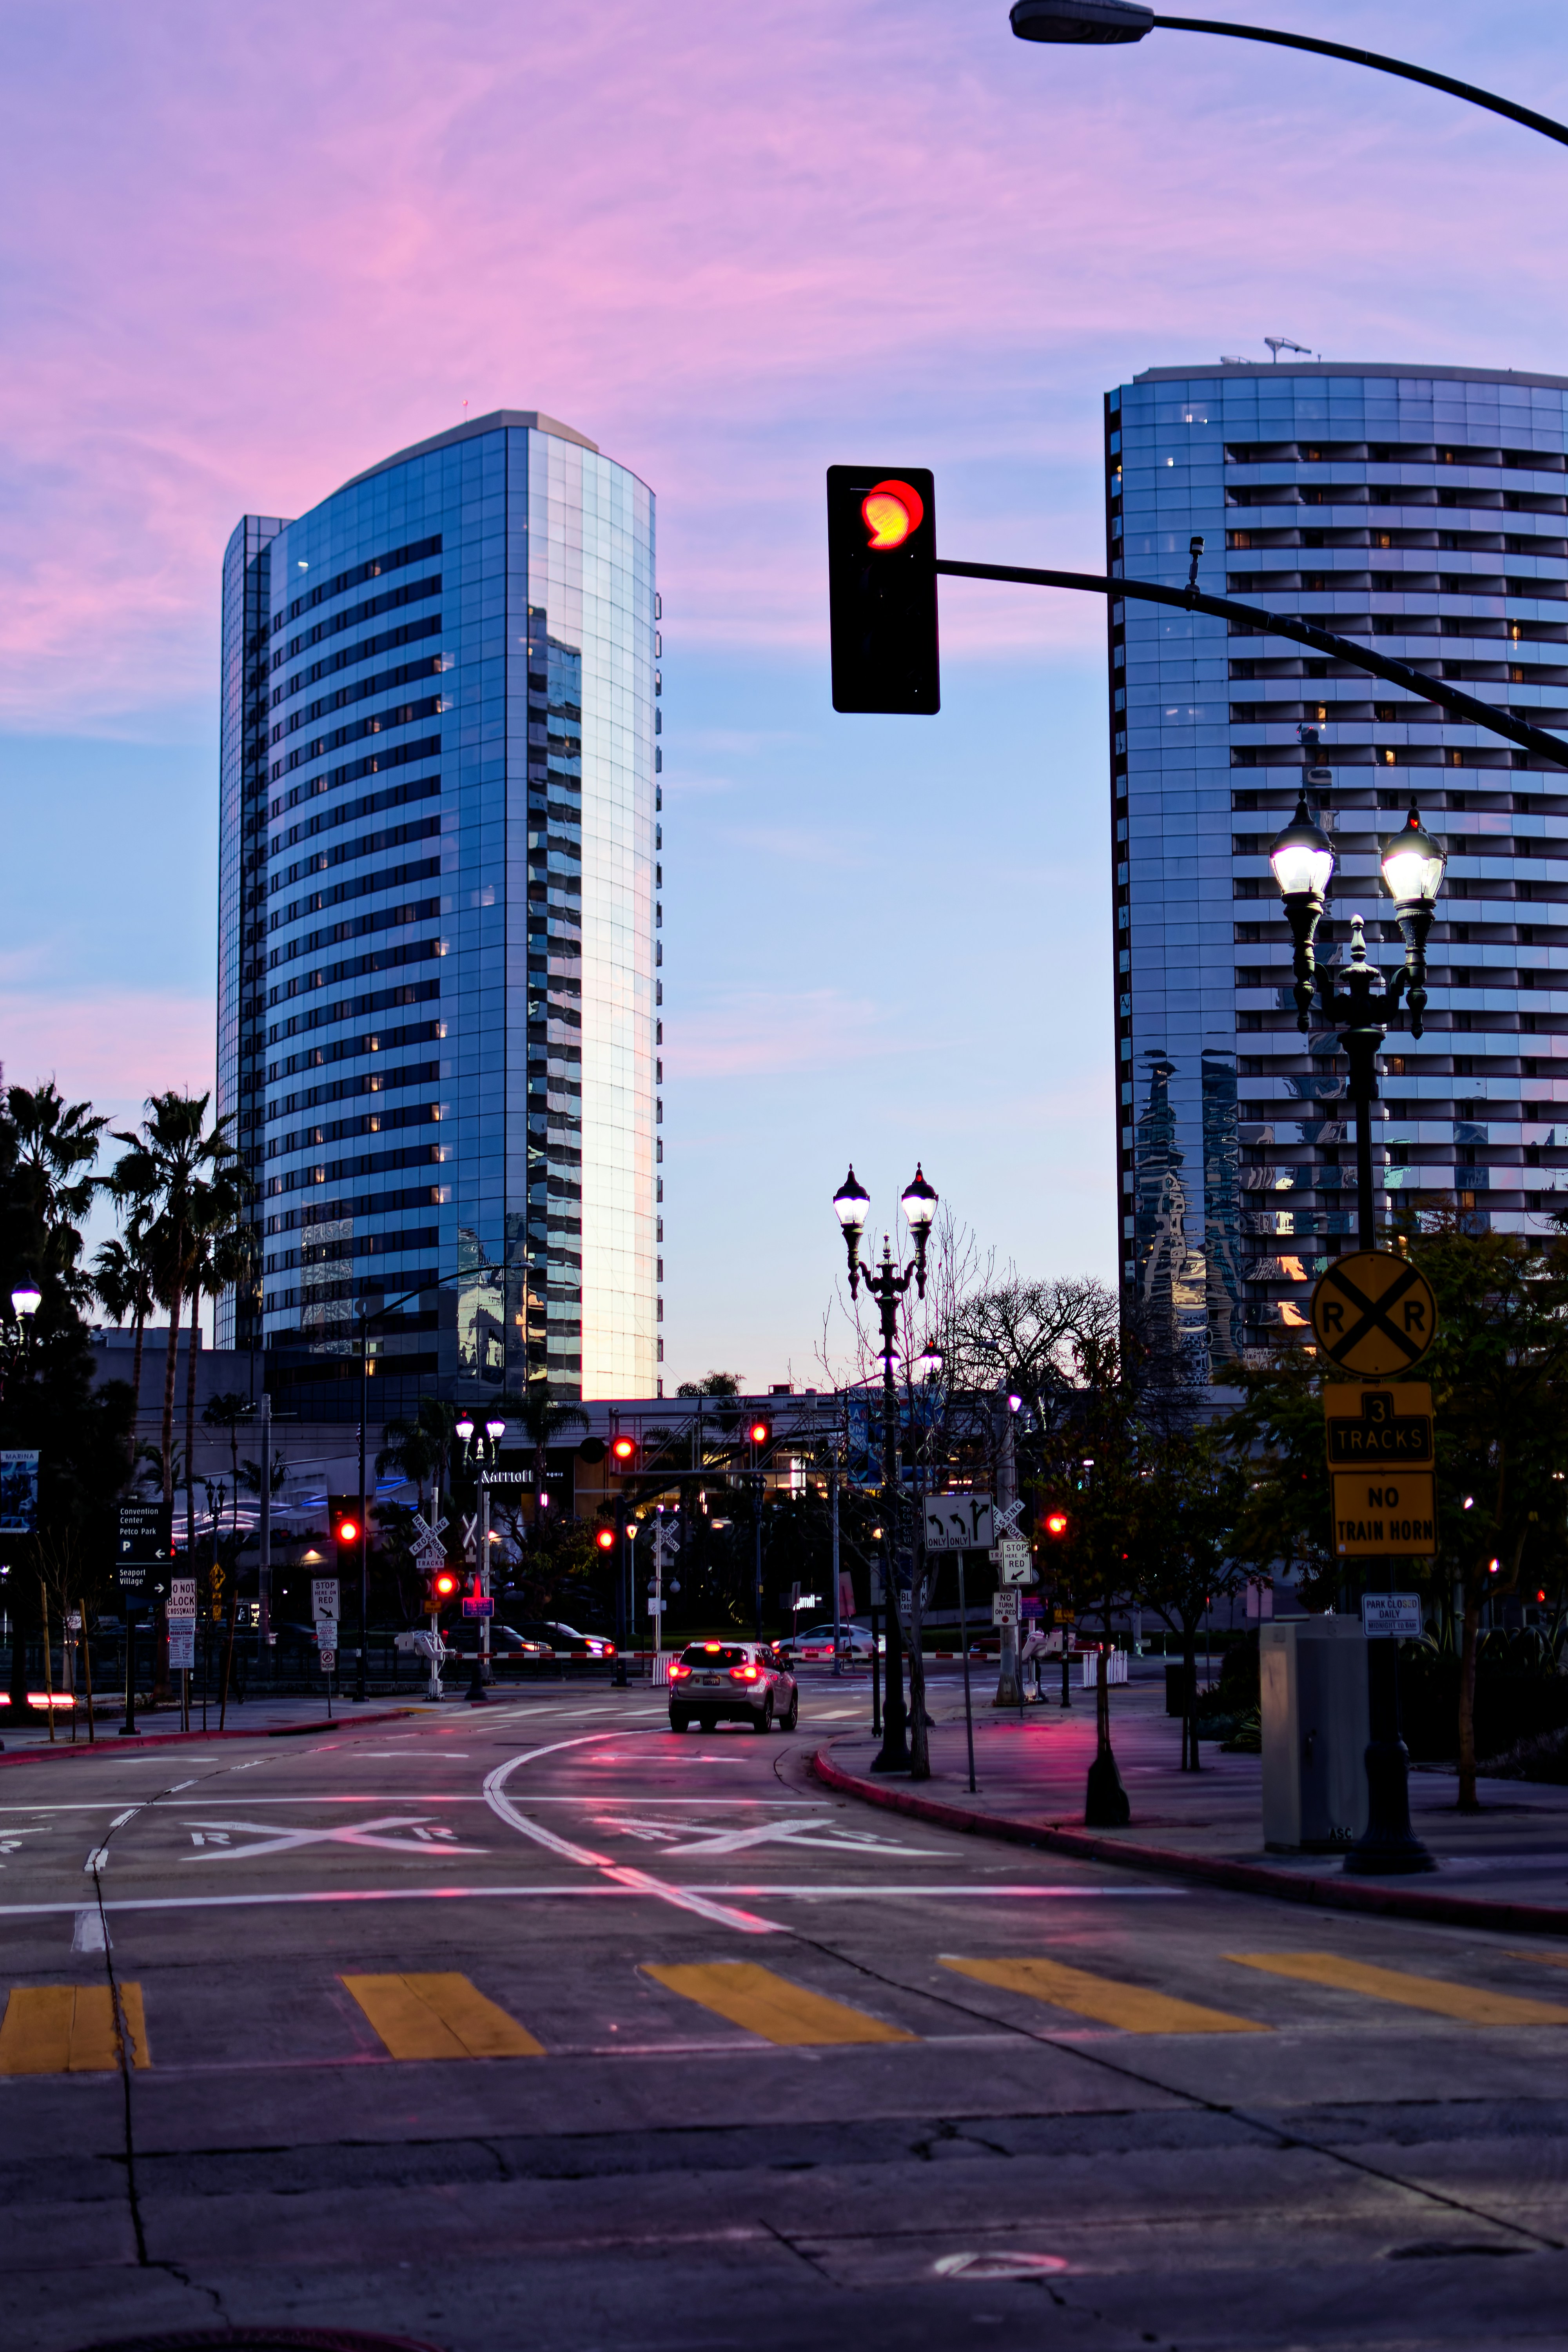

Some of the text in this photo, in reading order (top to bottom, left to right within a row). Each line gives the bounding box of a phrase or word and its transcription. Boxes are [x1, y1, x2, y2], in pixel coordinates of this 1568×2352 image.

[1323, 1301, 1425, 1332] R R
[1371, 1399, 1386, 1423] 3
[1337, 1429, 1422, 1450] TRACKS
[1368, 1488, 1399, 1507] NO
[995, 1503, 1021, 1531] OSSING
[1338, 1520, 1433, 1541] TRAIN HORN
[412, 1521, 446, 1552] CROSSING
[950, 1537, 967, 1546] ONLY
[123, 1541, 131, 1552] P
[928, 1538, 946, 1546] ONLY
[120, 1569, 146, 1577] Seaport
[120, 1578, 143, 1586] Village
[180, 1584, 194, 1593] NOT
[168, 1597, 194, 1606] BLOCK
[902, 1593, 926, 1601] BLK
[1367, 1599, 1417, 1608] PARK CLOSED
[1379, 1610, 1400, 1618] DAILY
[1330, 1828, 1352, 1841] ASC
